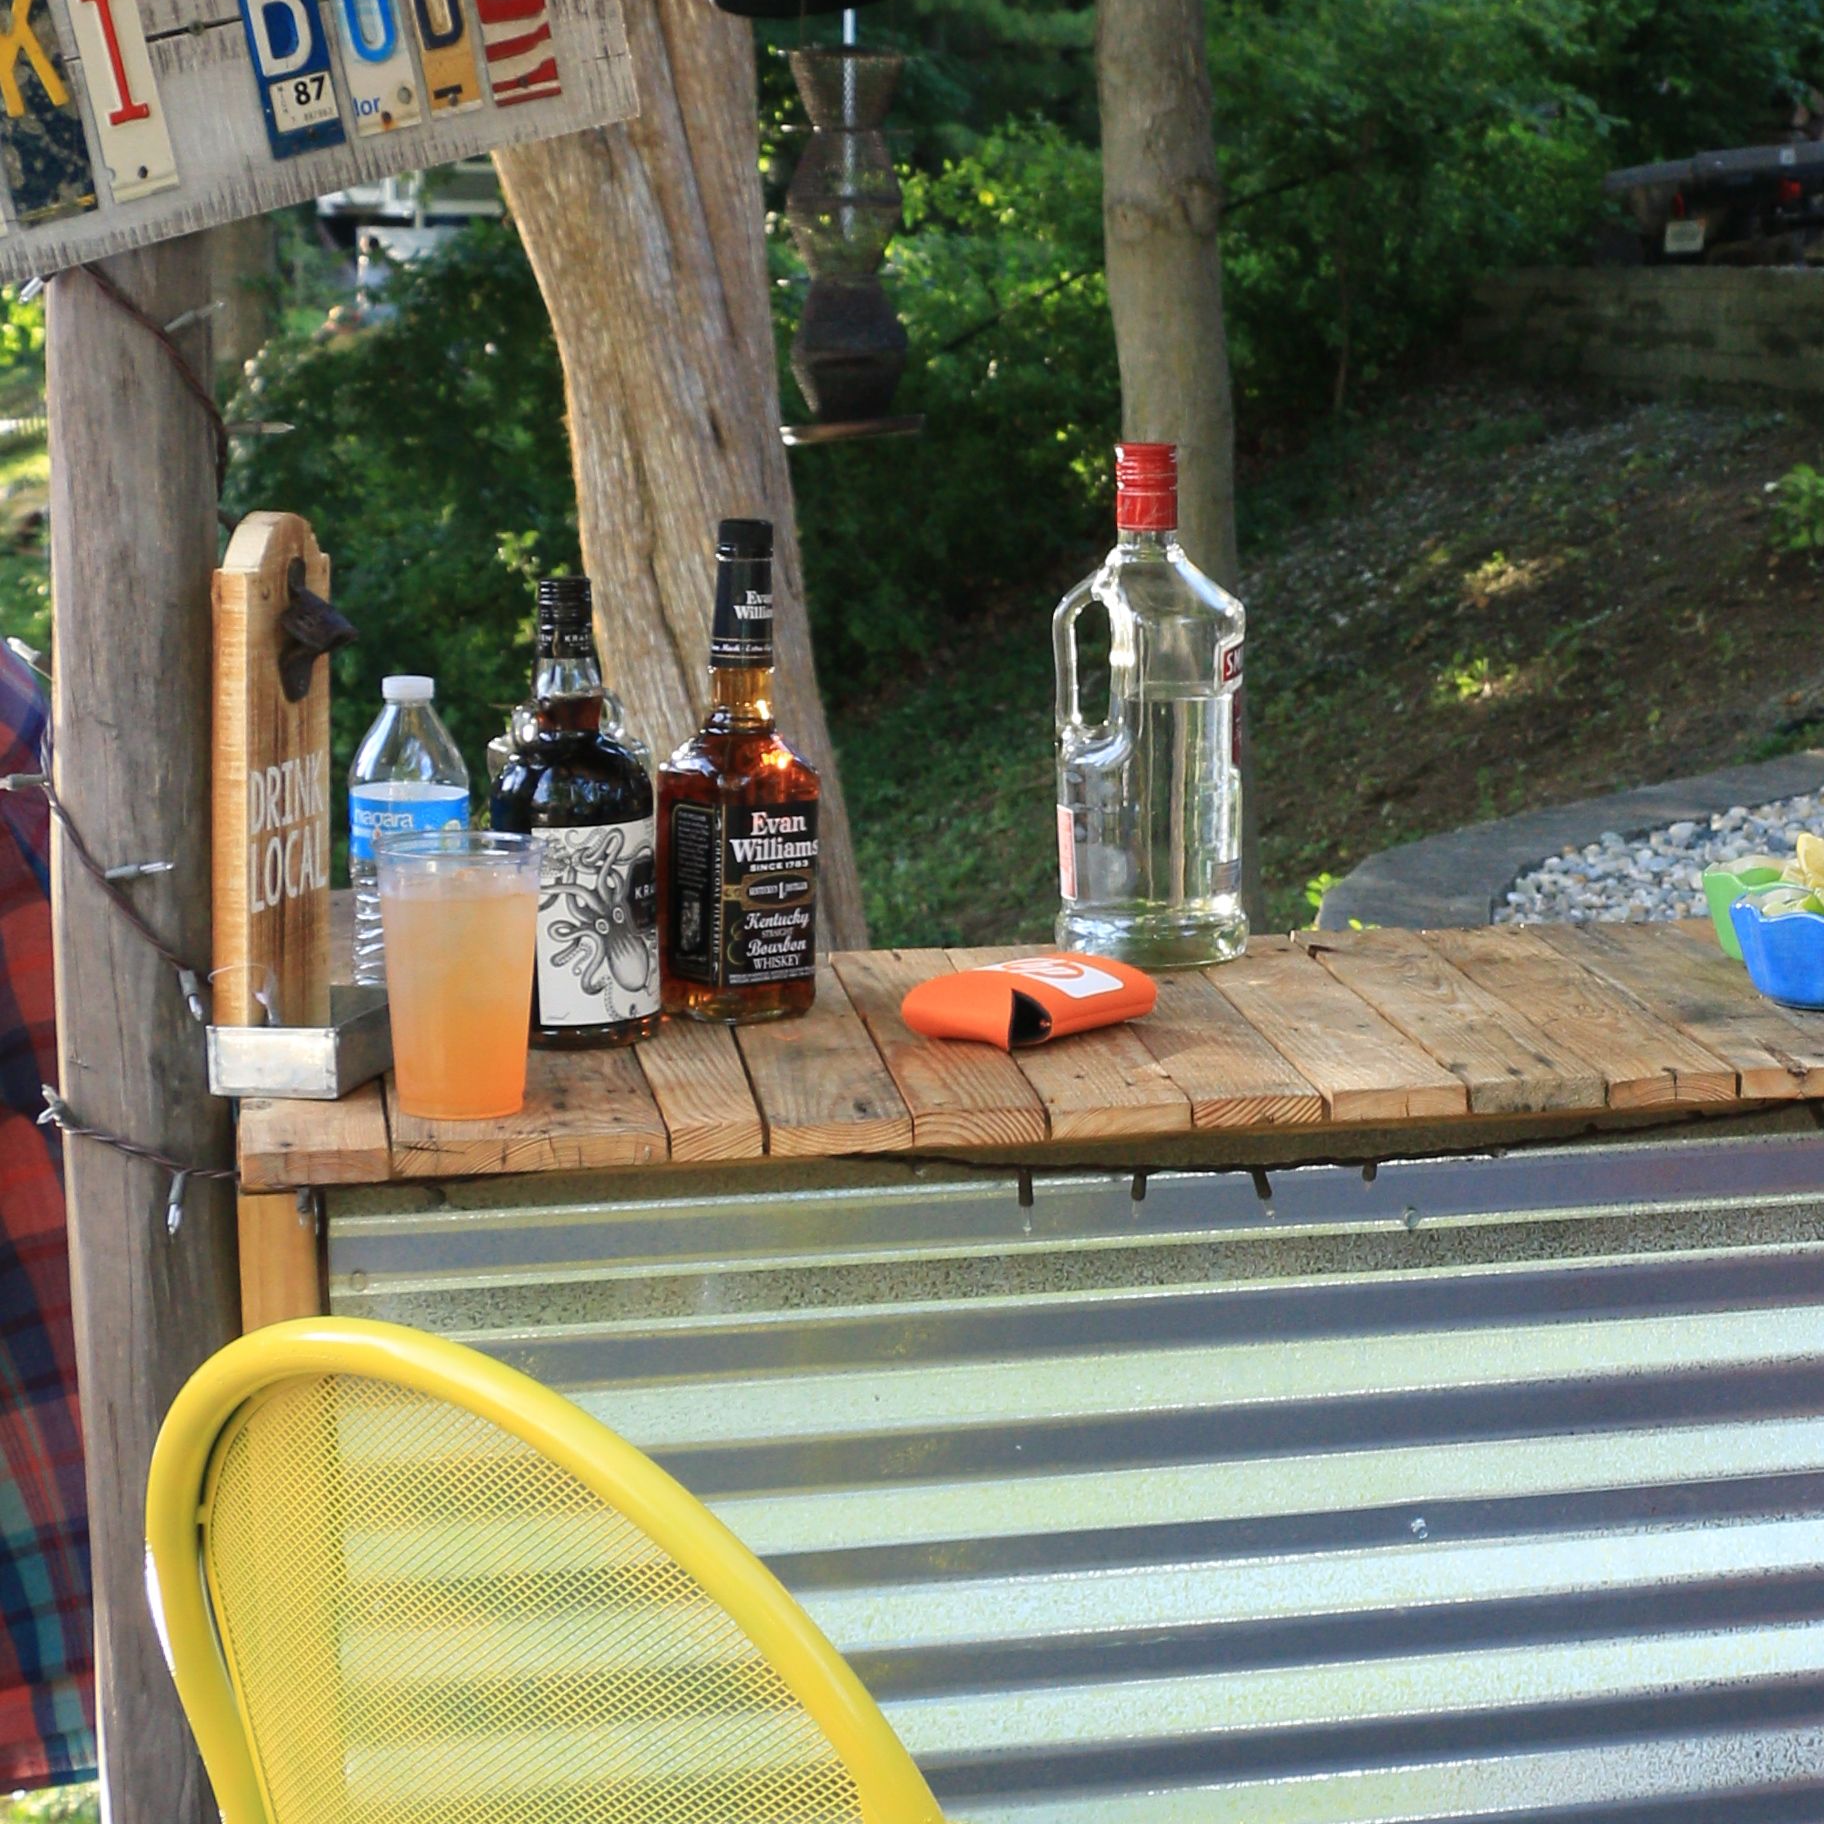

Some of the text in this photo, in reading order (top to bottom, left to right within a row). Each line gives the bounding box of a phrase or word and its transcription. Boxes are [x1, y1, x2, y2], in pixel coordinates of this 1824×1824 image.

[293, 75, 325, 106] 87
[249, 749, 325, 836] DRINK
[750, 810, 807, 836] Evan
[728, 836, 820, 864] Williams
[250, 820, 328, 914] LOCAL
[749, 862, 784, 873] SINCE
[743, 907, 810, 930] Kentucky
[746, 936, 808, 957] Bourbon
[752, 954, 801, 970] WHISKEY
